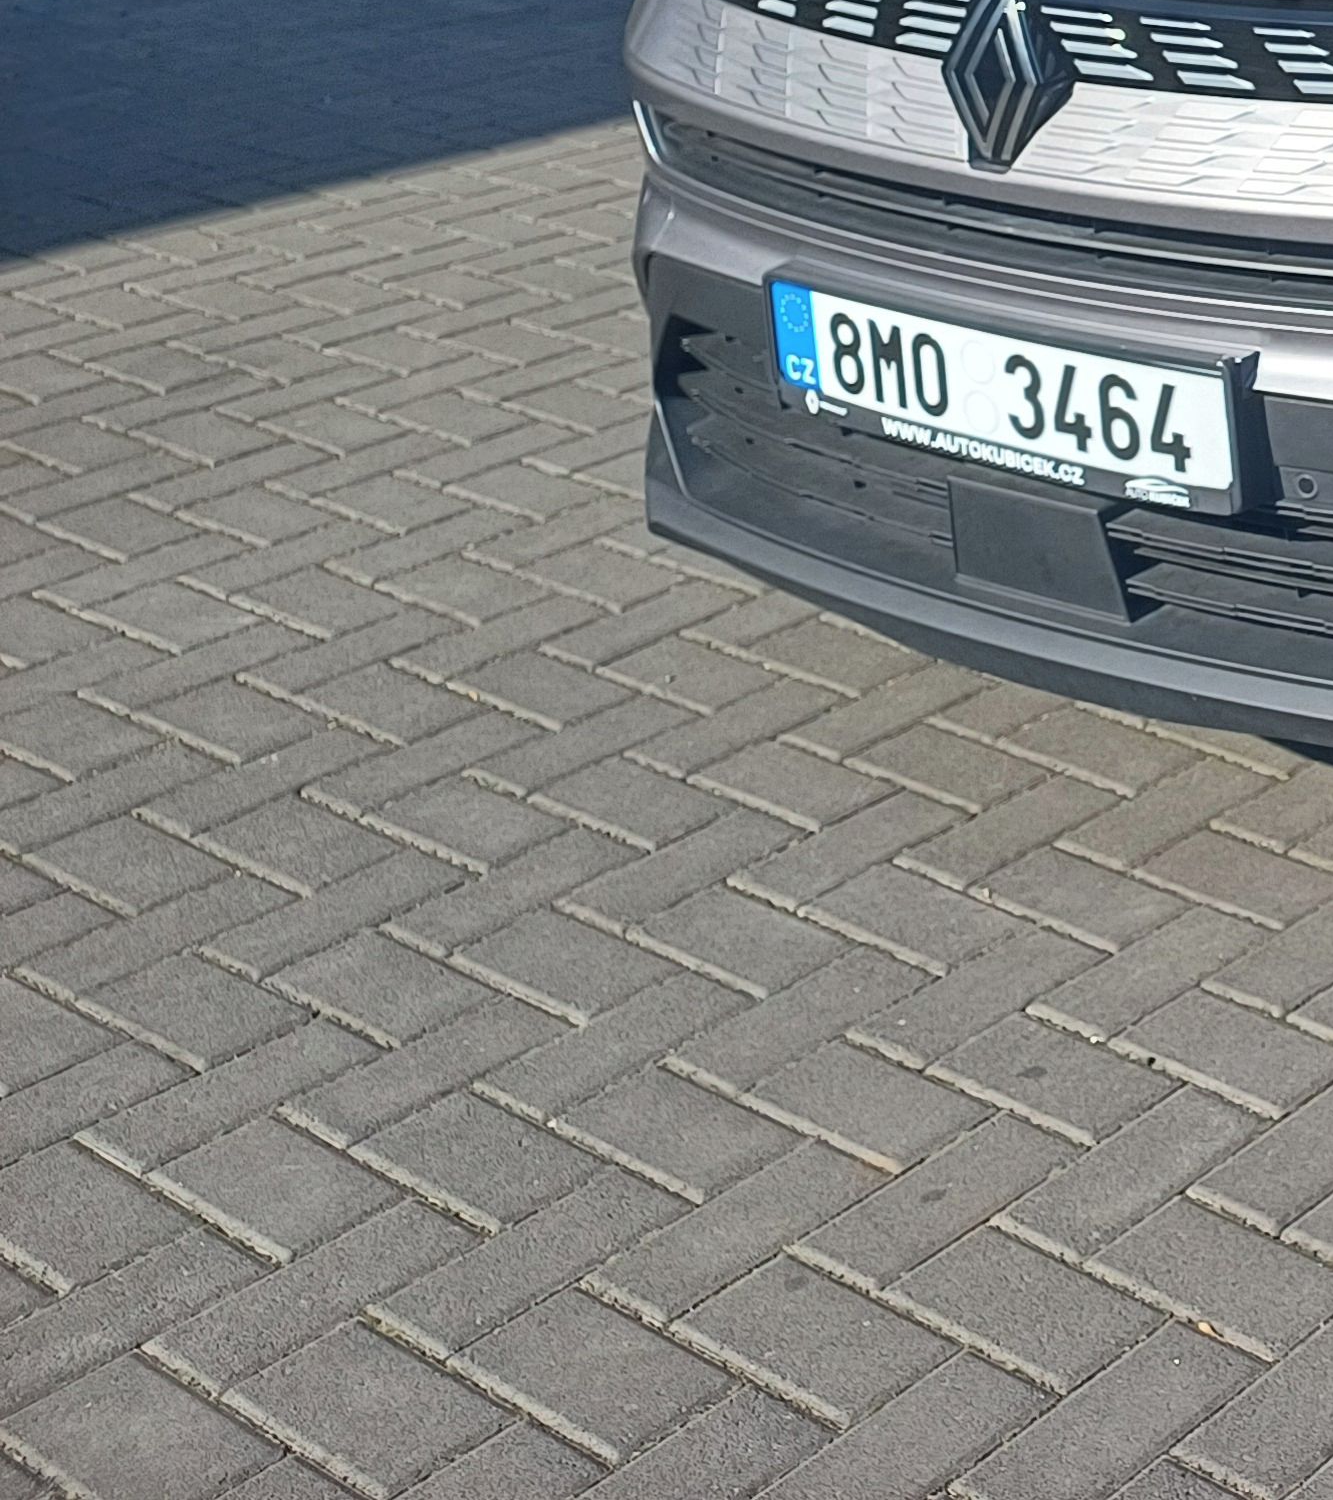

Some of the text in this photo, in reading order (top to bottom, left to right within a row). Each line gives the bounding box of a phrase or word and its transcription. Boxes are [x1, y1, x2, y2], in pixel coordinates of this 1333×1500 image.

[785, 353, 817, 385] CZ
[1003, 354, 1192, 474] 3464
[880, 416, 1086, 487] WWW.AUTOKUBICEK.CZ
